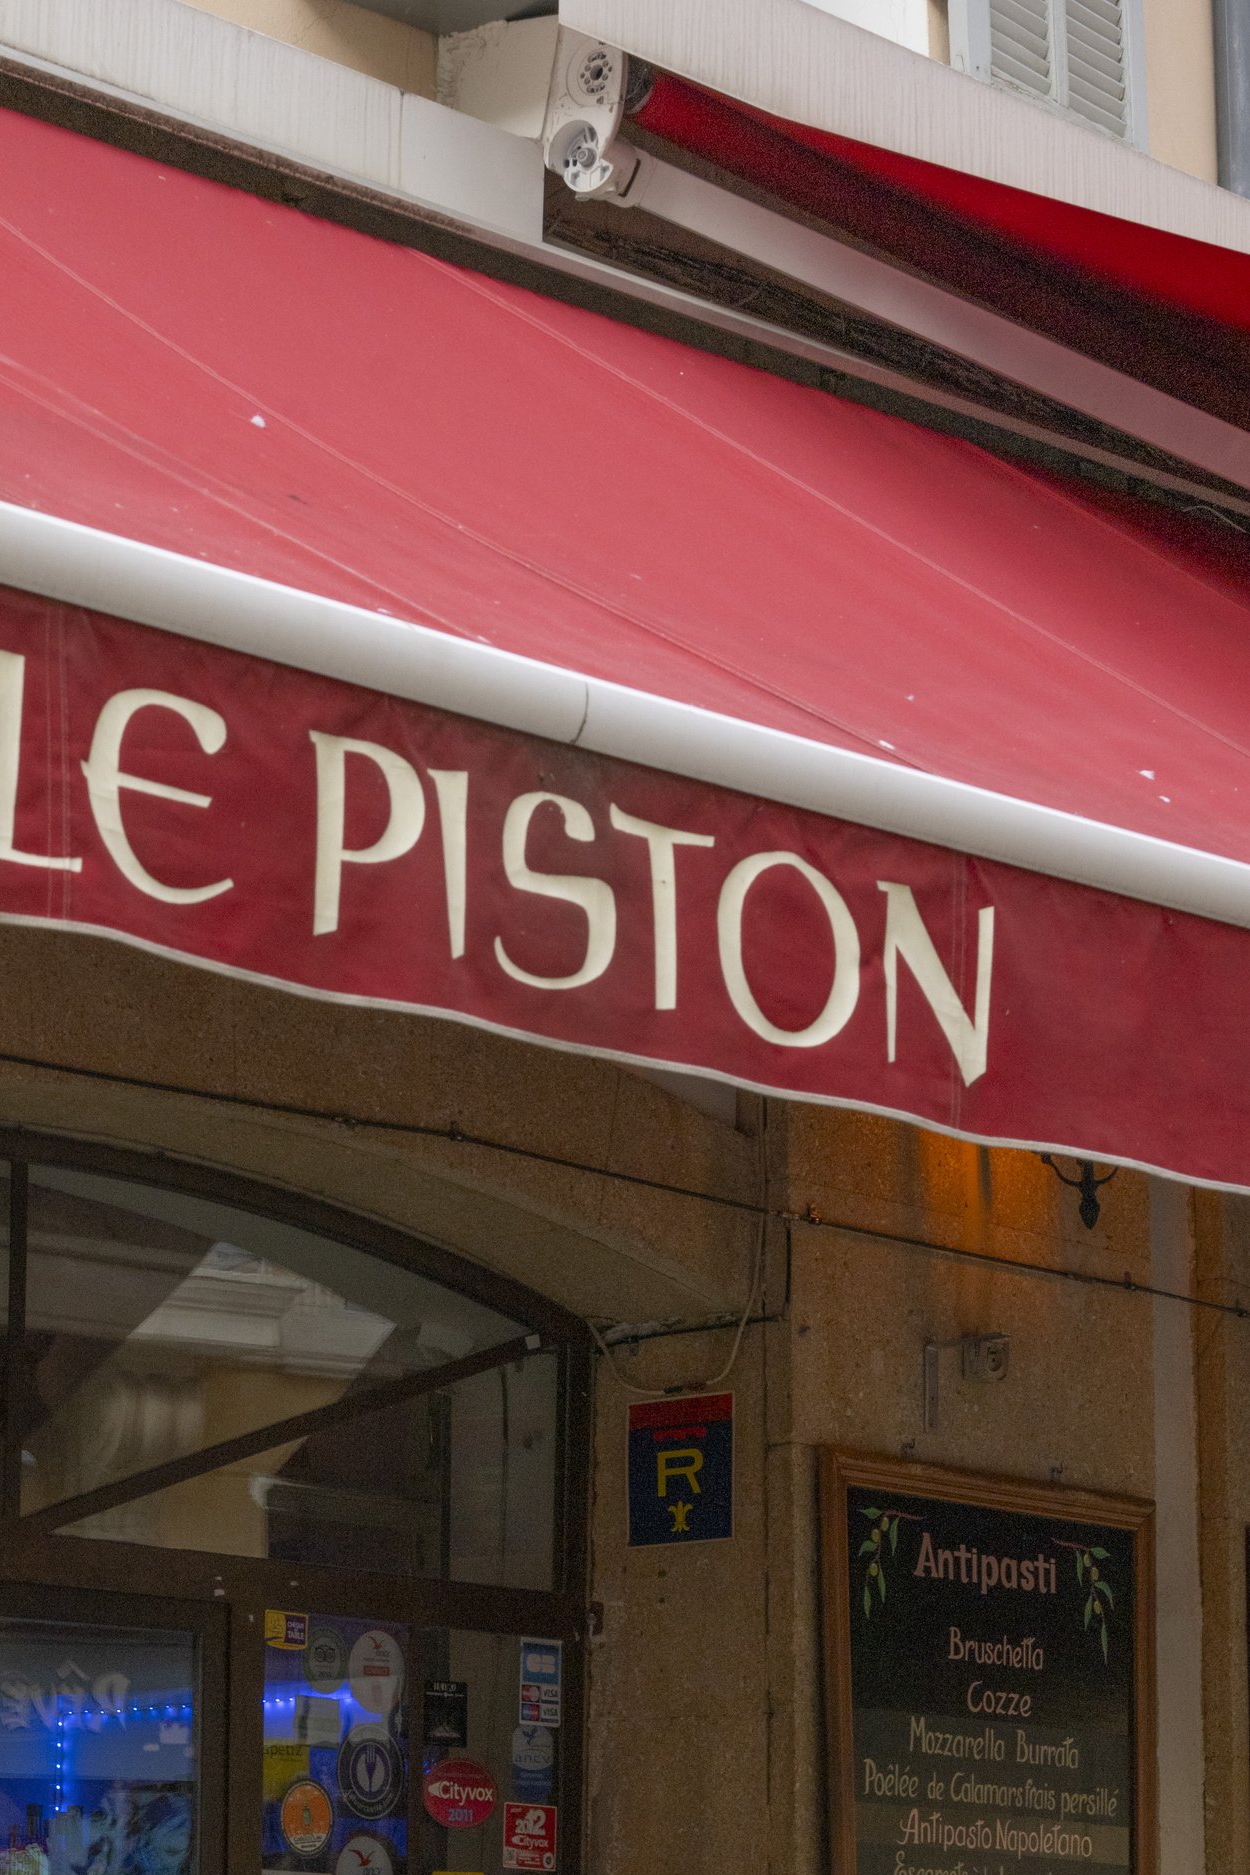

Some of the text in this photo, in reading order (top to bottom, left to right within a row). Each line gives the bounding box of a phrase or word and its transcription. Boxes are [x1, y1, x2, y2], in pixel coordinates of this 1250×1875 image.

[309, 728, 995, 1088] PISTON
[657, 1447, 704, 1497] R
[913, 1532, 1058, 1595] Antipasti
[948, 1626, 1044, 1671] Bruschetta
[966, 1680, 1032, 1717] Cozze
[909, 1715, 1079, 1769] Mozzarella Burrata
[439, 1780, 493, 1806] Cityvox
[863, 1758, 1119, 1820] Poêlée de Calamars frais persillé
[448, 1808, 473, 1822] 2011
[896, 1807, 1093, 1859] Antipasto Napoletano
[519, 1835, 549, 1850] Cityvox
